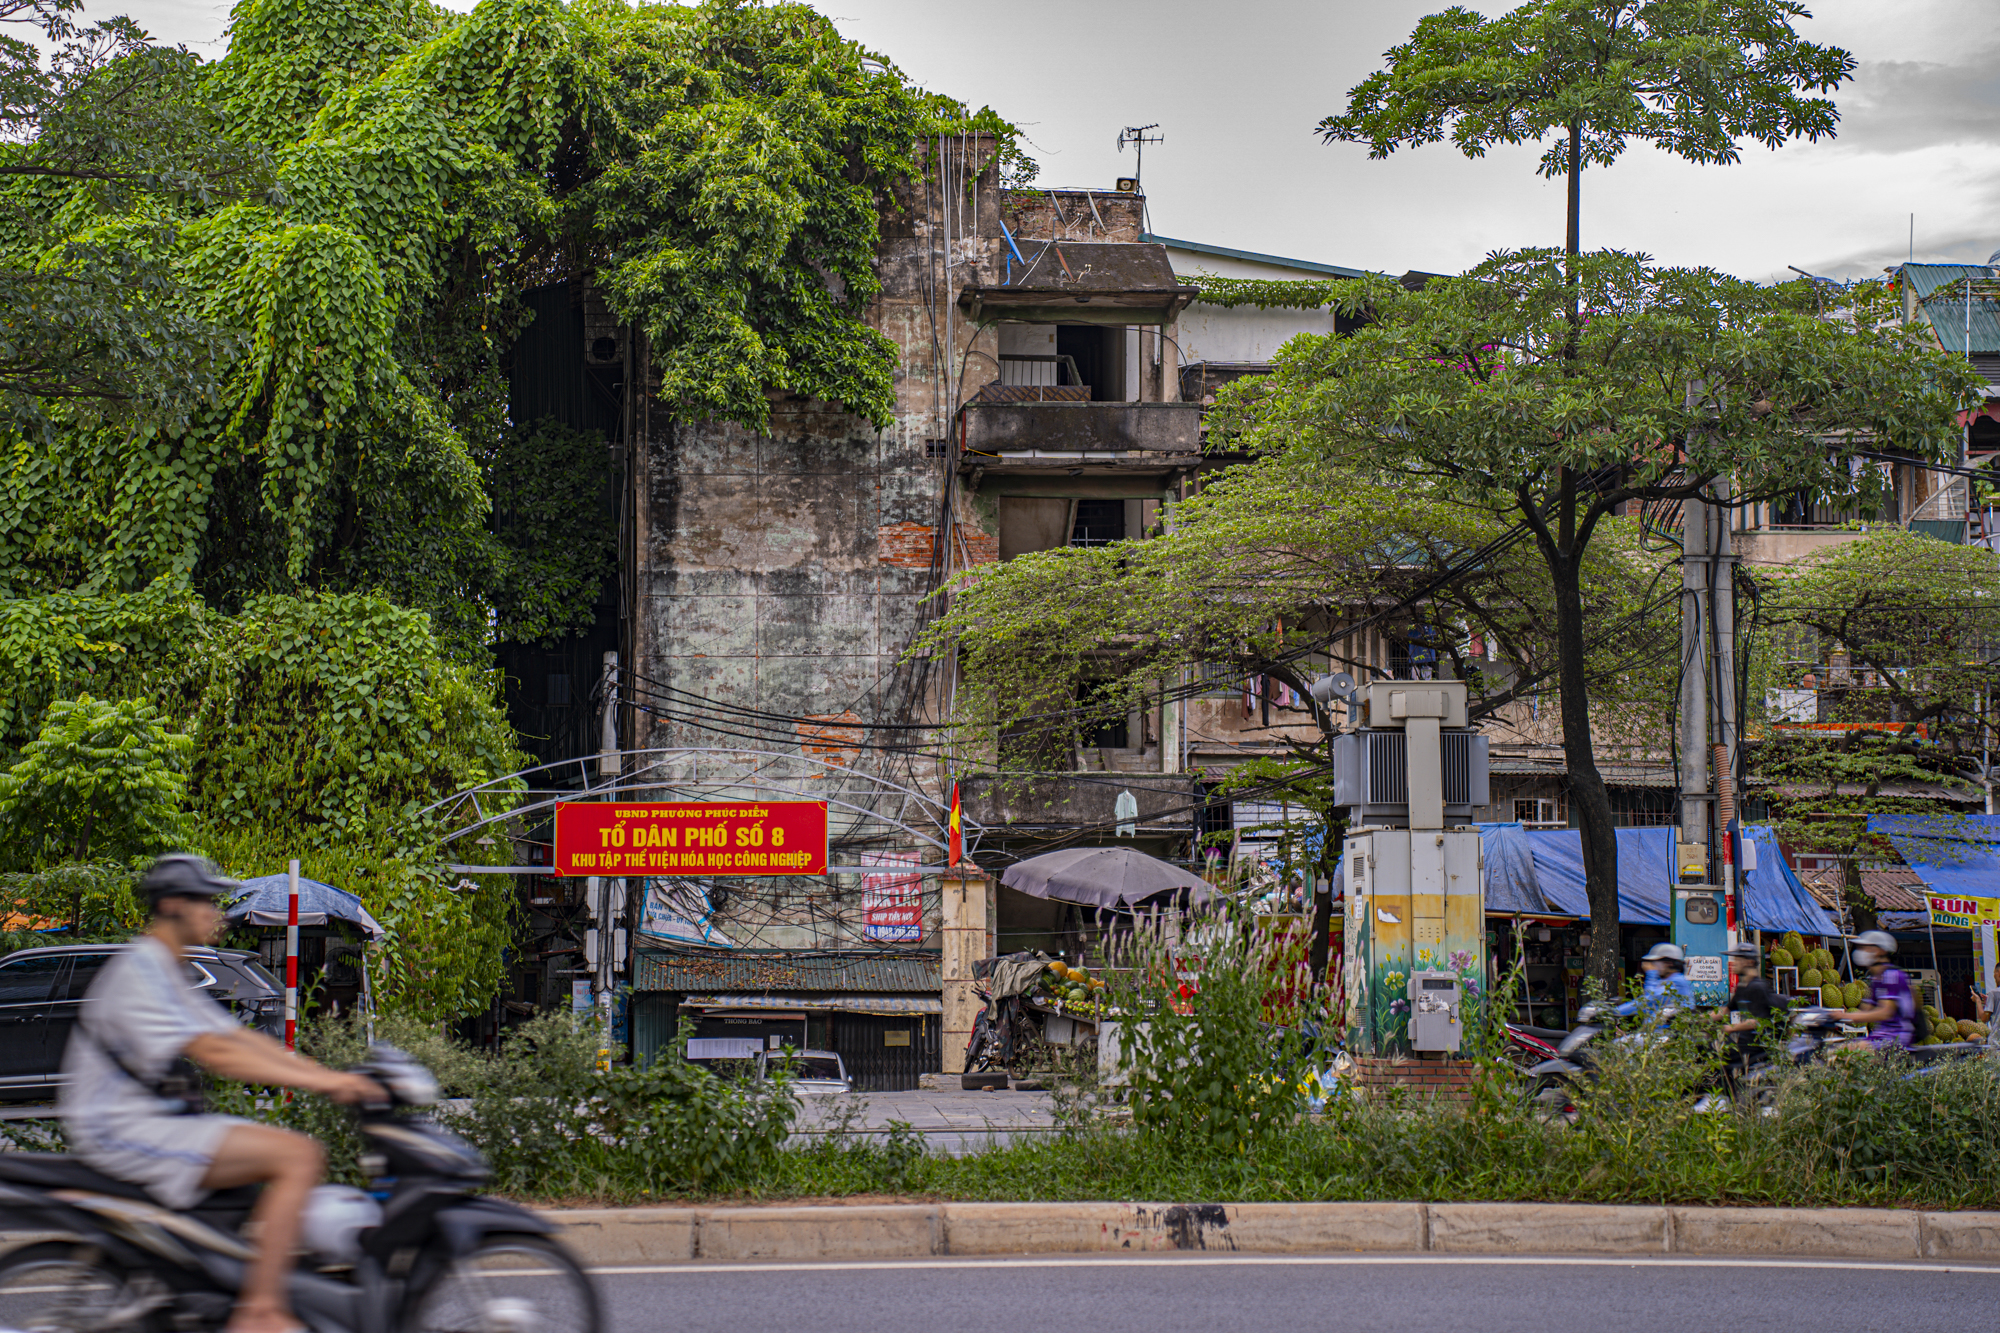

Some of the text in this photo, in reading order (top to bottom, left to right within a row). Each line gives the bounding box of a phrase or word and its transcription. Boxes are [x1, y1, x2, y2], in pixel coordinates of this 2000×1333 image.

[614, 804, 769, 818] UBND PHƯỜNG PHÚC DIỄN
[599, 820, 784, 847] TỔ DÂN PHỐ SỐ 8
[571, 848, 812, 870] KHU TẬP THỂ VIỆN HÓA HỌC CÔNG NGHIỆP
[1931, 897, 1977, 915] BÚN
[871, 912, 888, 921] SHIP
